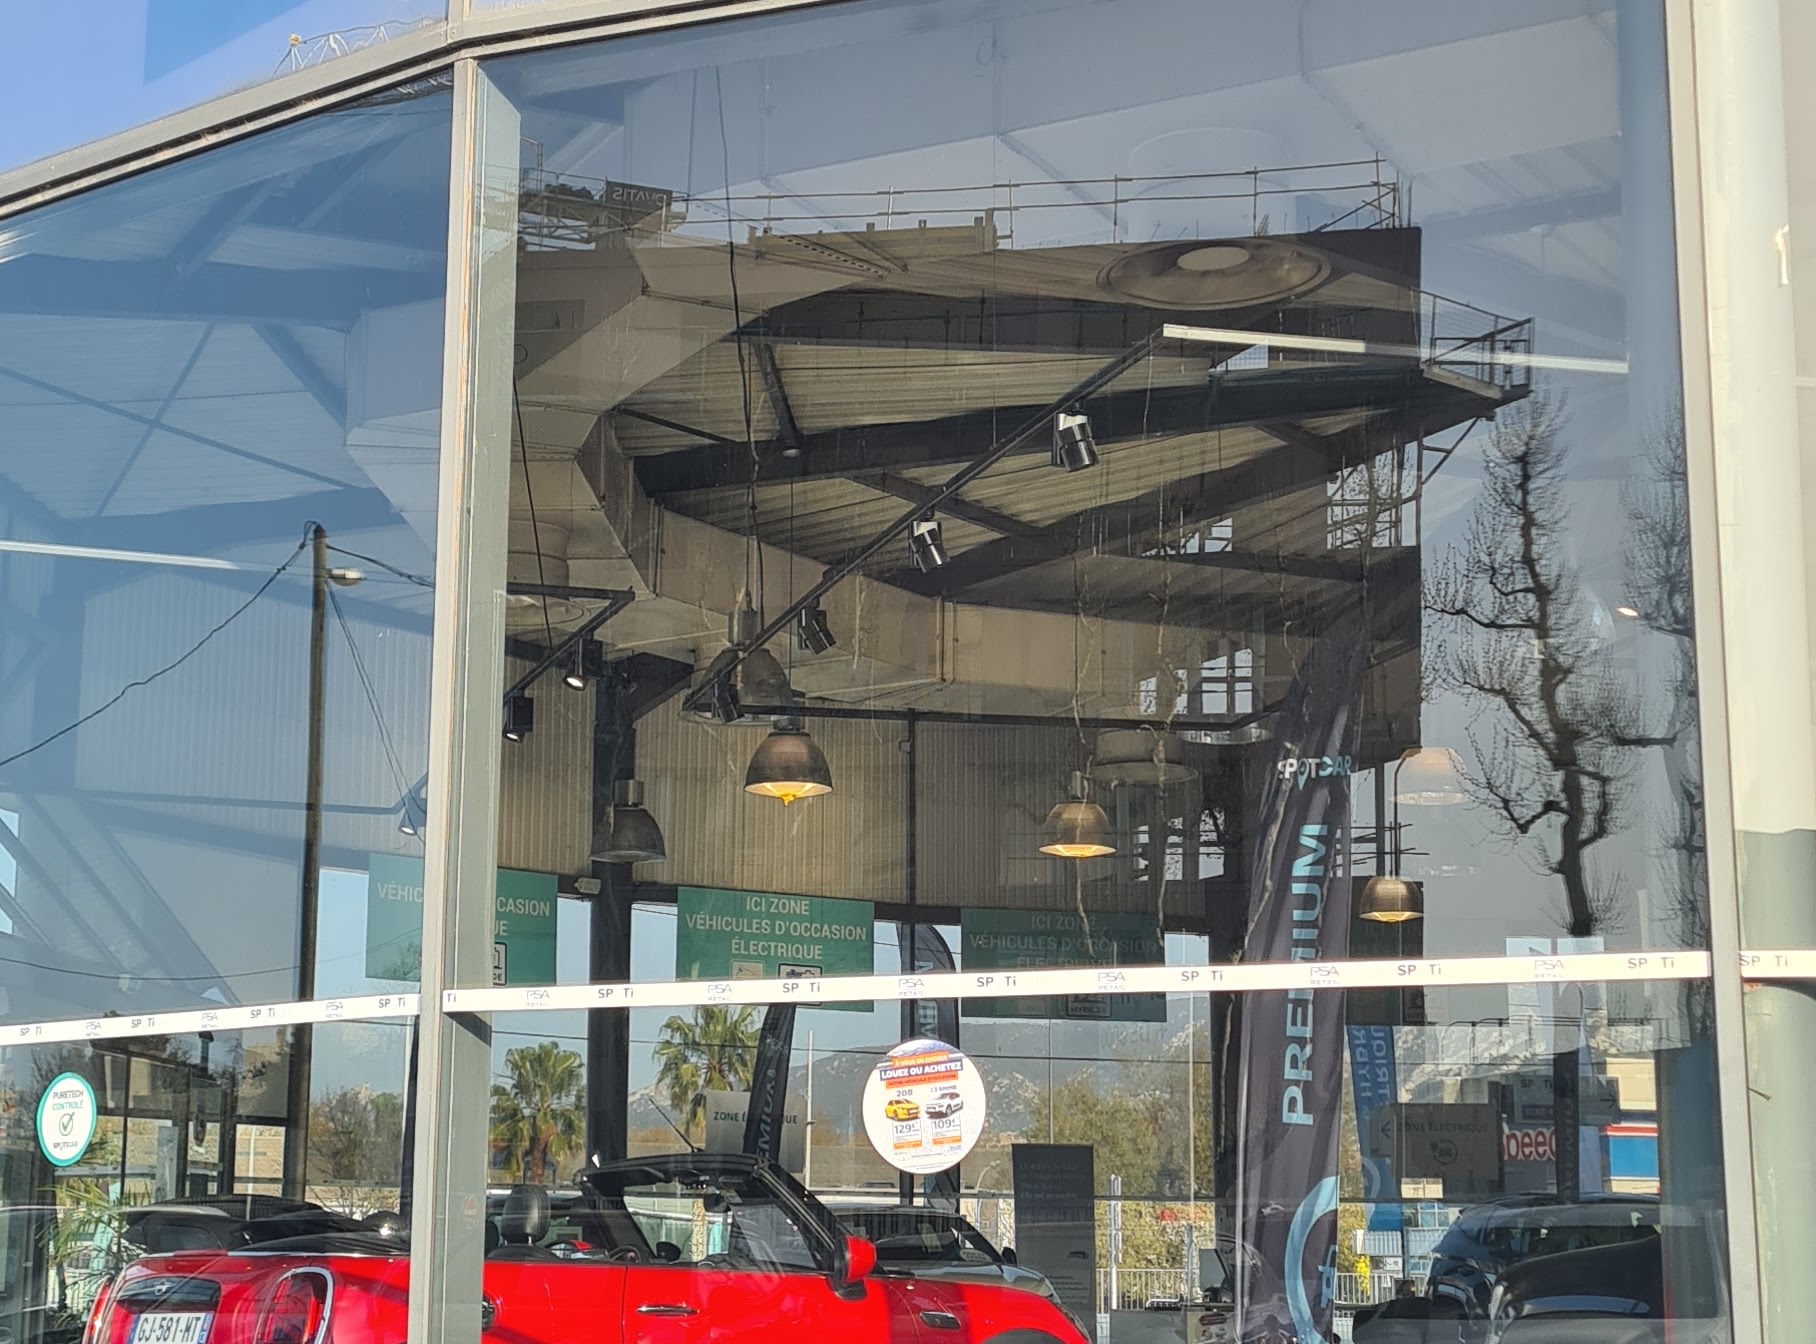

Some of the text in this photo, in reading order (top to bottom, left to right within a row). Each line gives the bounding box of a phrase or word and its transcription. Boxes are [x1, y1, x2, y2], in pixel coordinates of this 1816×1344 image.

[377, 881, 550, 917] VÉHIC CASION
[746, 896, 810, 915] ICI ZONE
[686, 911, 867, 941] VÉHICULES D'OCCASION
[1032, 915, 1049, 929] ICI
[731, 936, 823, 960] ÉLECTRIQUE
[969, 931, 1057, 951] VÉHICULES
[881, 1061, 961, 1079] LOUEZ OU ACHETEZ
[896, 1089, 913, 1097] 208
[713, 1112, 739, 1122] ZONE
